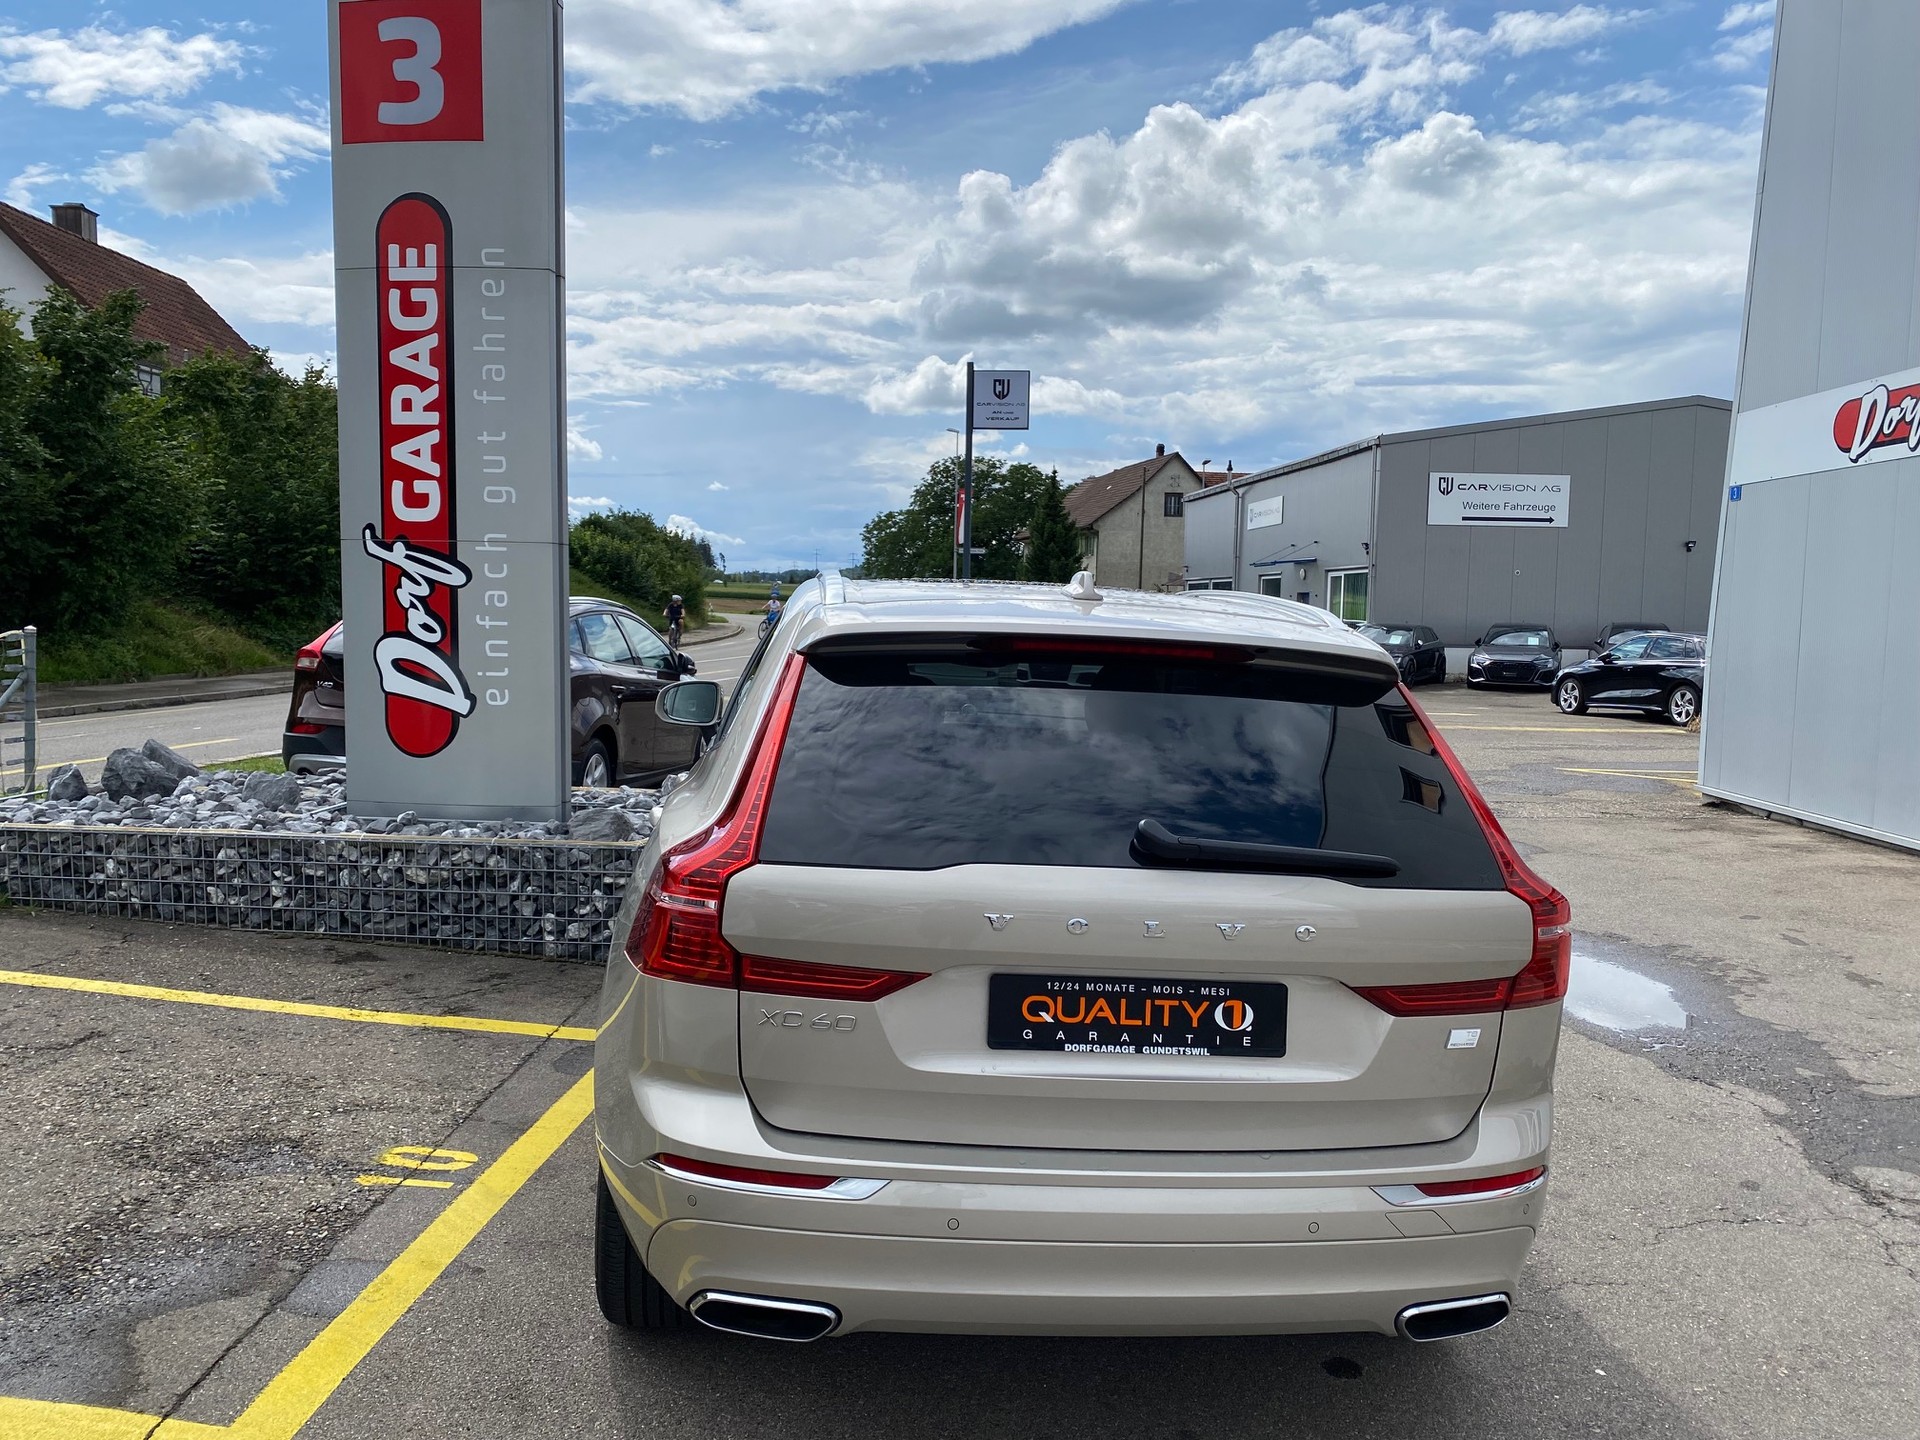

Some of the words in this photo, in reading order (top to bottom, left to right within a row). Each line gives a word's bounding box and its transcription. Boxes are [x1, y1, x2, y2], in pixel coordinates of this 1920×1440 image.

[377, 16, 445, 125] 3
[473, 247, 507, 404] fahren
[387, 243, 441, 523] GARAGE
[477, 430, 517, 504] gut
[1457, 483, 1537, 492] CARVISION
[1540, 484, 1562, 493] AG
[1462, 501, 1501, 511] Weitere
[1503, 502, 1557, 514] Fahrzeuge
[363, 525, 475, 717] Dorf
[474, 532, 510, 706] einfach
[983, 912, 1317, 942] VOLVO
[1047, 981, 1080, 991] 12/24
[1086, 983, 1136, 993] MONATE
[1152, 985, 1183, 995] MOIS
[1201, 986, 1230, 996] MESI
[1021, 995, 1210, 1028] QUALITY
[1022, 1029, 1251, 1046] GARANTIE
[1064, 1043, 1136, 1054] DORFGARAGE
[1142, 1044, 1210, 1056] GUNDETSWIL
